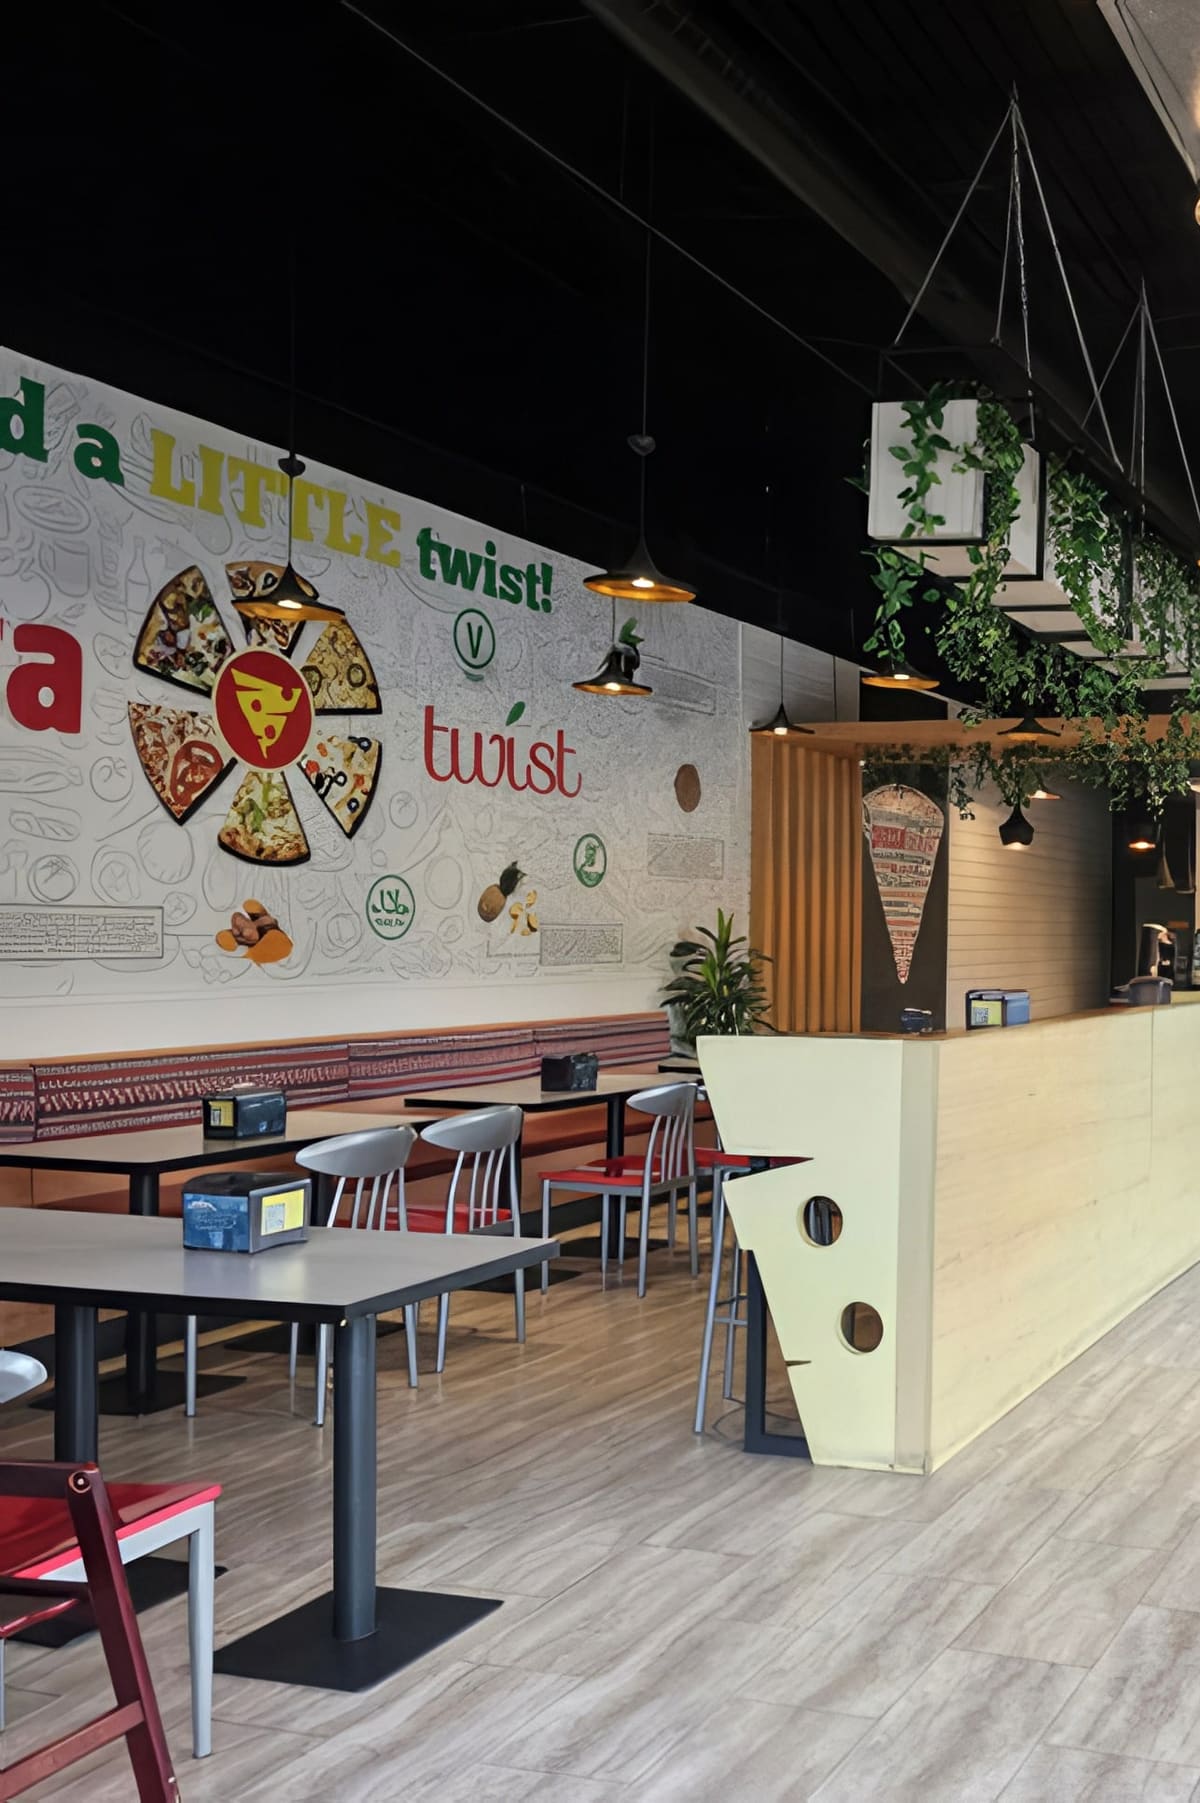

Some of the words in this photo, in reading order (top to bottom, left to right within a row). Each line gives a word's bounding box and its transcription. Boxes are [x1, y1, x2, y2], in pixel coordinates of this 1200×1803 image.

[73, 423, 125, 487] a
[150, 428, 402, 569] LITTLE
[417, 527, 553, 614] twist!
[424, 701, 582, 798] twist
